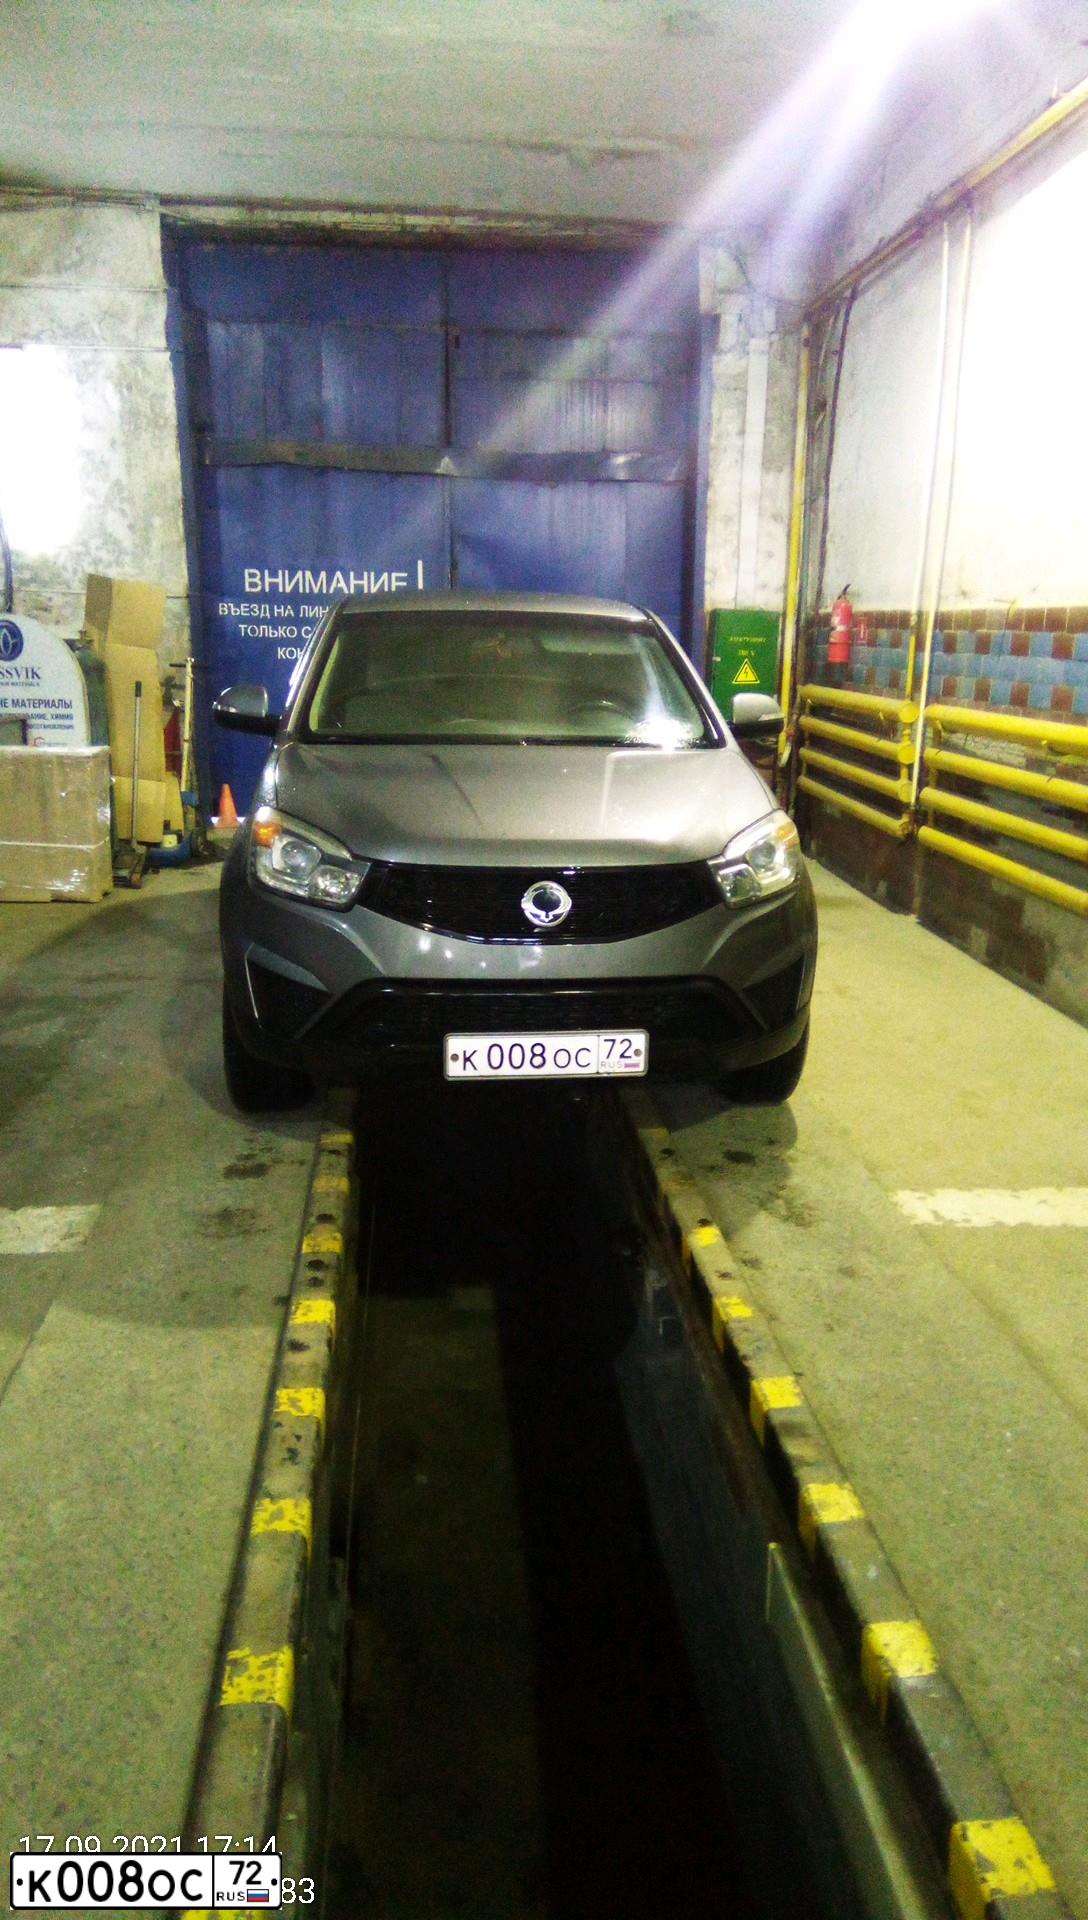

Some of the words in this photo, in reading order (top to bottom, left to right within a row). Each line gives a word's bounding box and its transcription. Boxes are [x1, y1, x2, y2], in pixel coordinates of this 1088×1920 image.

[244, 568, 408, 594] ВНИМАНИЕ
[219, 602, 270, 619] ВЪЕЗД
[274, 605, 295, 617] НА
[299, 605, 330, 618] ЛИН
[239, 624, 298, 639] ТОЛЬКО
[0, 666, 41, 680] SSVIK
[11, 698, 73, 709] МАТЕРИАЛЫ
[603, 1039, 633, 1059] 72
[601, 1060, 623, 1069] RUS
